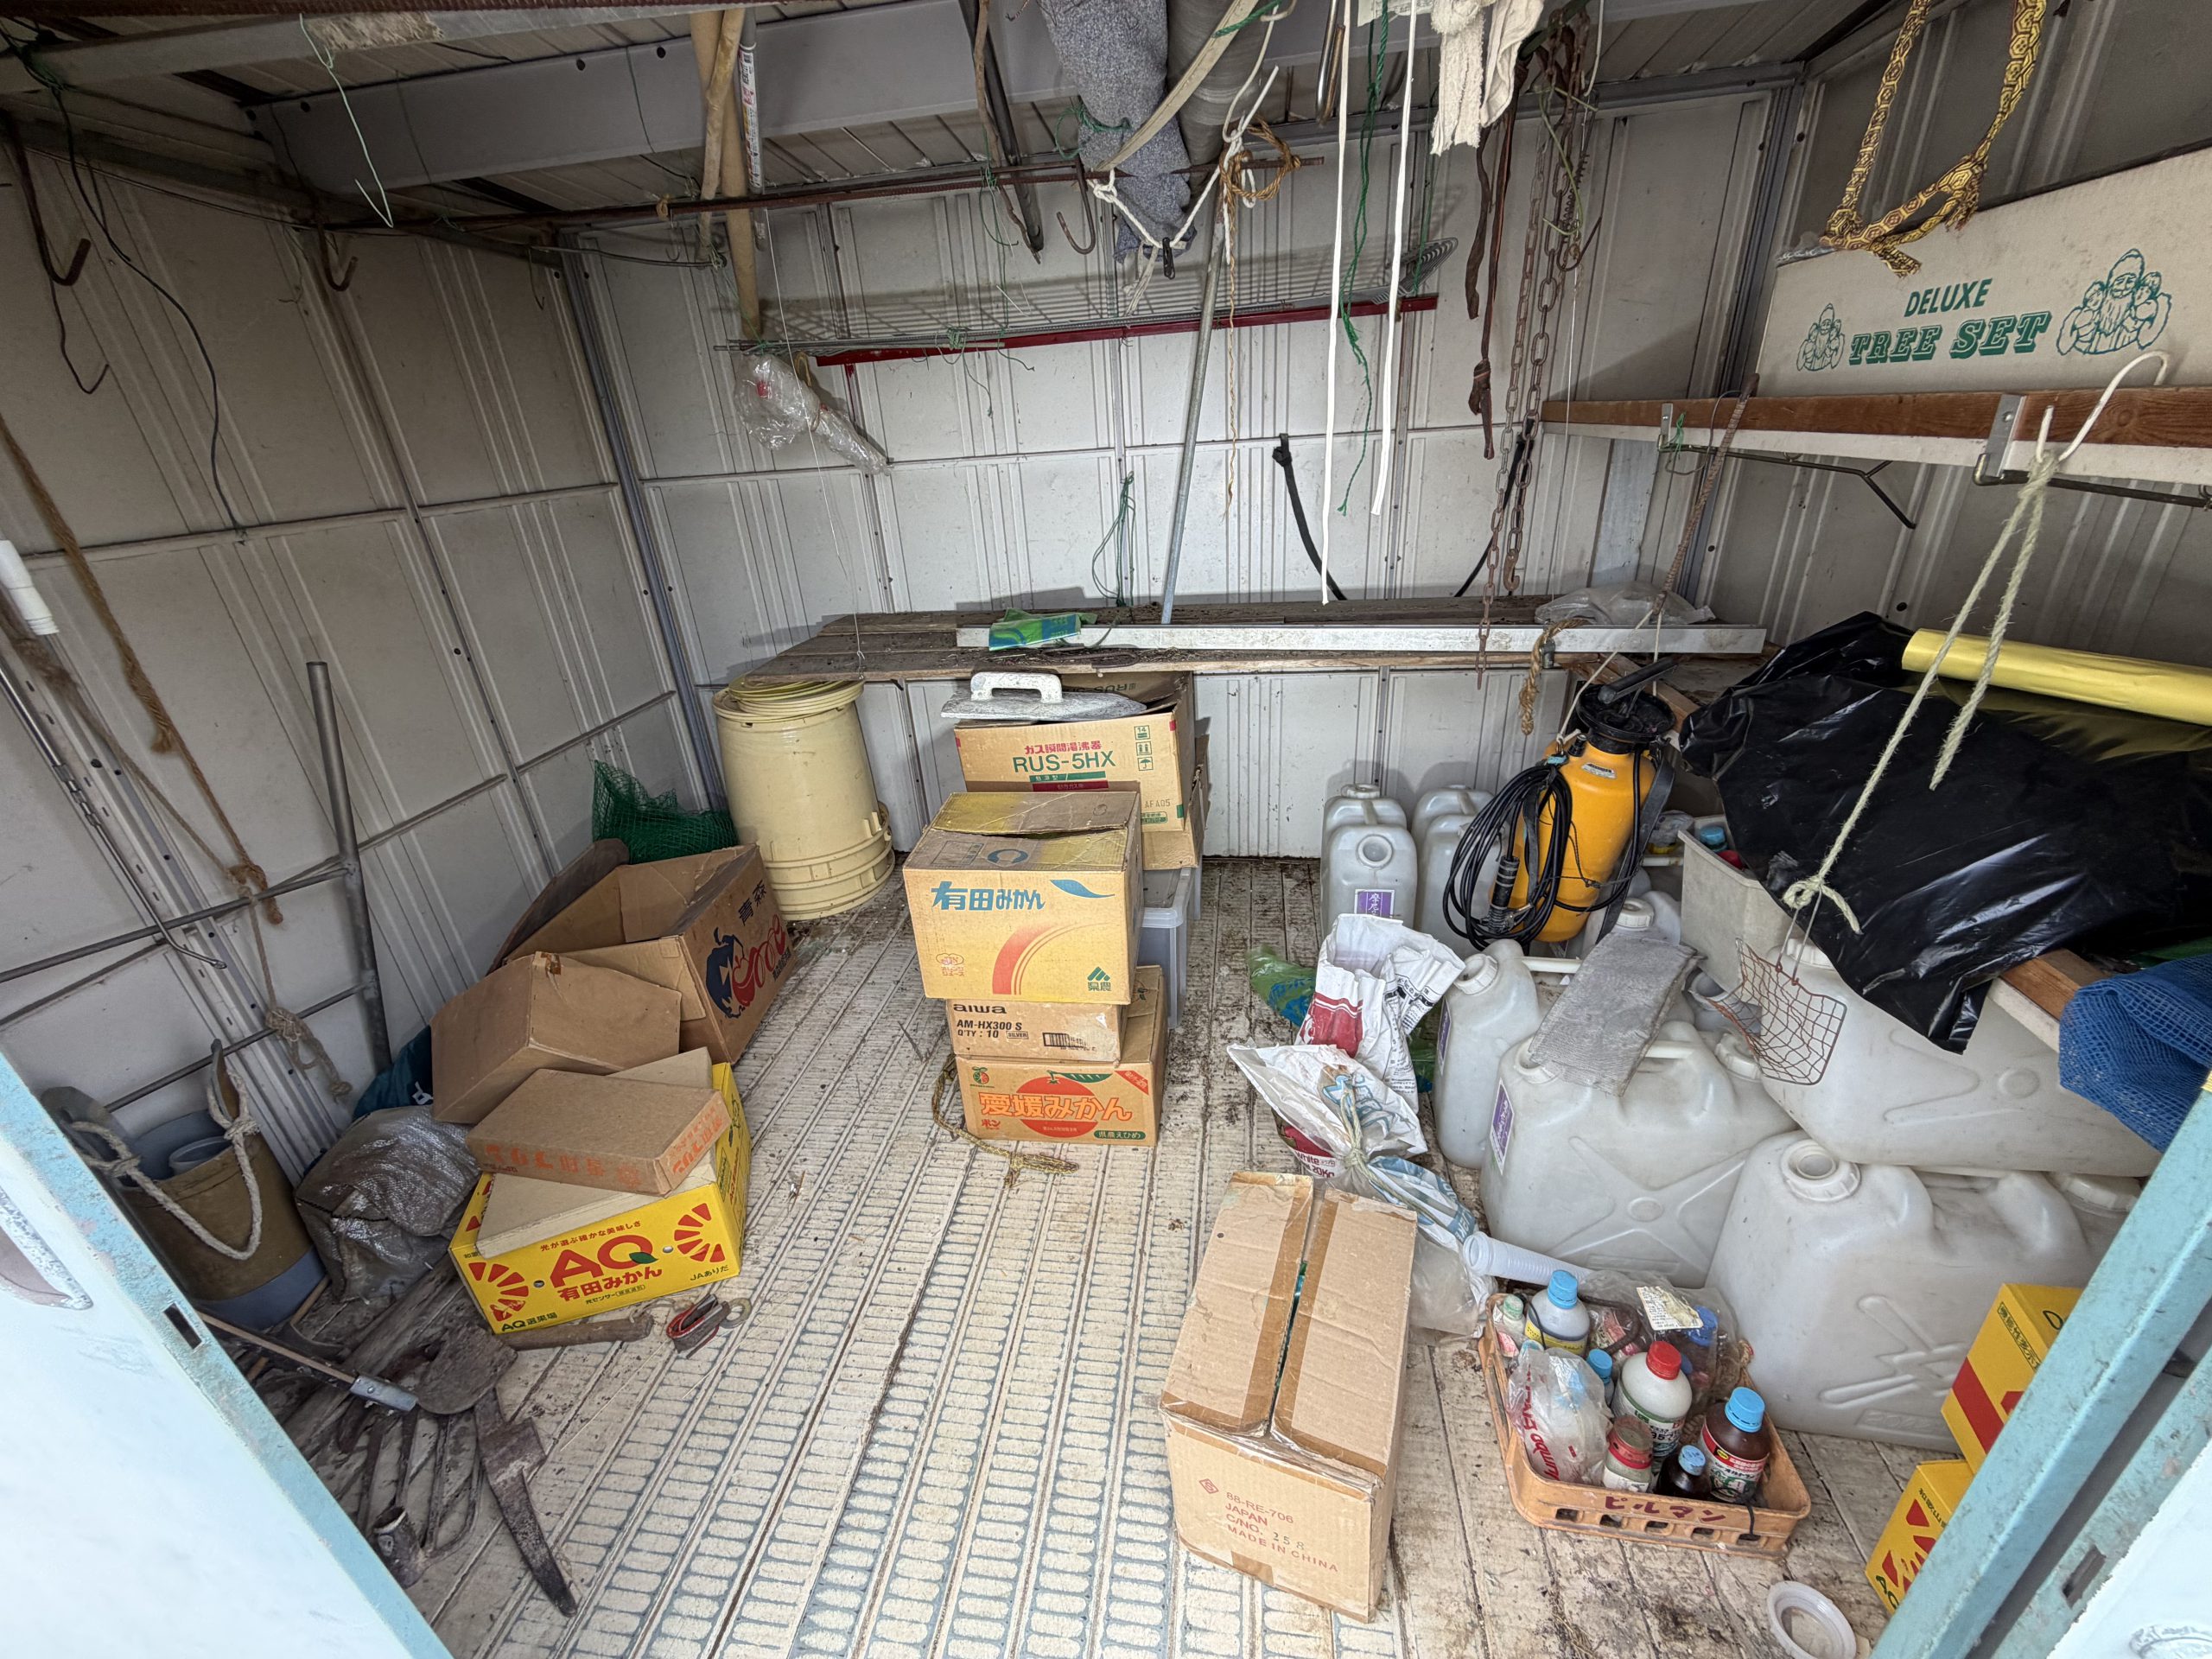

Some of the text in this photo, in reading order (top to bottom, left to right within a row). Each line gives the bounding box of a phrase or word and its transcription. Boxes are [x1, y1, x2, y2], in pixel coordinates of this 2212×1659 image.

[1904, 278, 1992, 317] DELUXE
[1849, 311, 2053, 365] TREE SET
[1024, 740, 1103, 755] ガス瞬間湯沸器
[1012, 750, 1116, 772] RUS-5HX
[738, 879, 767, 926] 青森
[930, 880, 1046, 912] 有田みかん
[1087, 982, 1112, 992] 県農
[953, 1003, 1007, 1014] aiwa
[956, 1019, 1023, 1031] AM-HX300 S
[987, 1029, 1000, 1039] 10
[978, 1091, 1134, 1122] 愛媛みかん
[1097, 1130, 1141, 1139] 県農えひめ
[539, 1220, 641, 1252] 光が選ぶ確かな美味しさ
[550, 1234, 653, 1288] AQ
[690, 1264, 729, 1281] JAありだ
[556, 1266, 663, 1302] 有田みかん
[502, 1312, 558, 1332] AQ選果場
[1224, 1503, 1268, 1526] JAPAN
[1226, 1491, 1294, 1523] 88-RE-706
[1225, 1513, 1263, 1535] C/NO.
[1227, 1524, 1338, 1573] MADE IN CHINA
